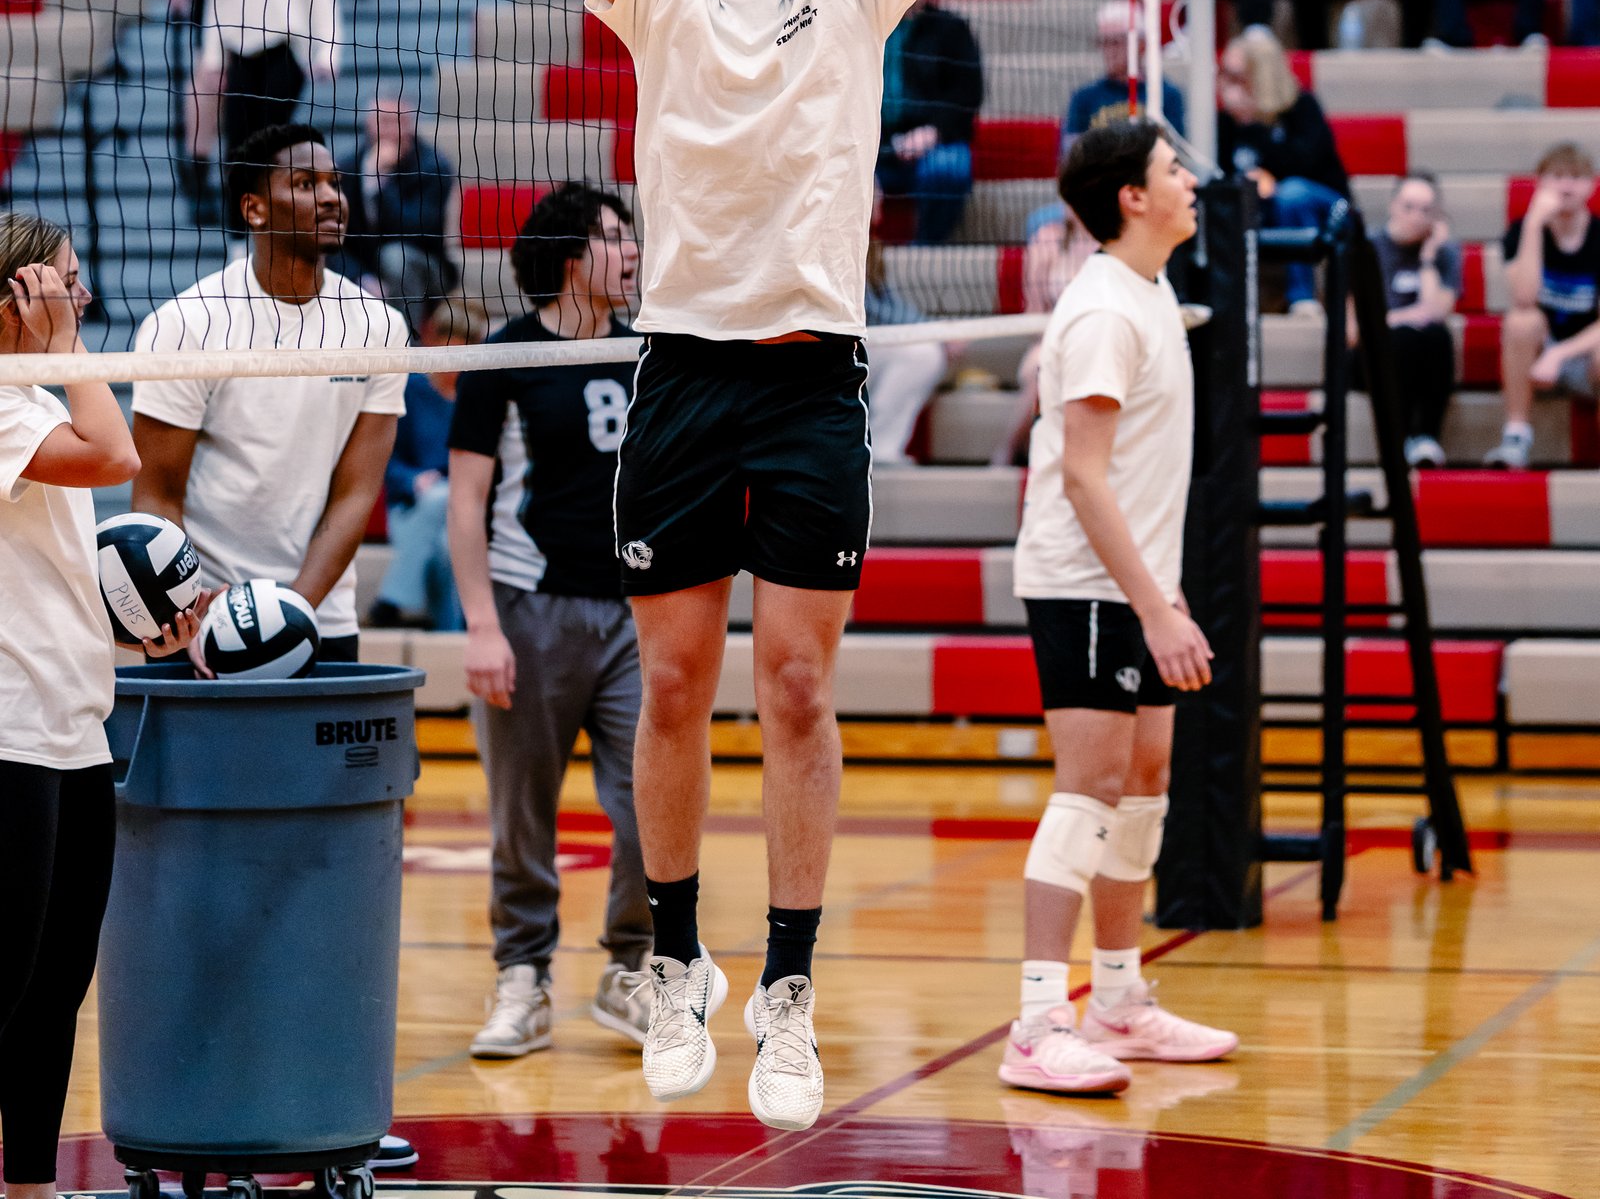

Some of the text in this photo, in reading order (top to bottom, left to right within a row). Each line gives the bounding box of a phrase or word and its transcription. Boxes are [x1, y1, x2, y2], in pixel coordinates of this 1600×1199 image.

[800, 8, 817, 29] NIGT
[583, 379, 628, 453] 8
[107, 581, 147, 626] PNHS
[316, 717, 398, 746] BRUTE
